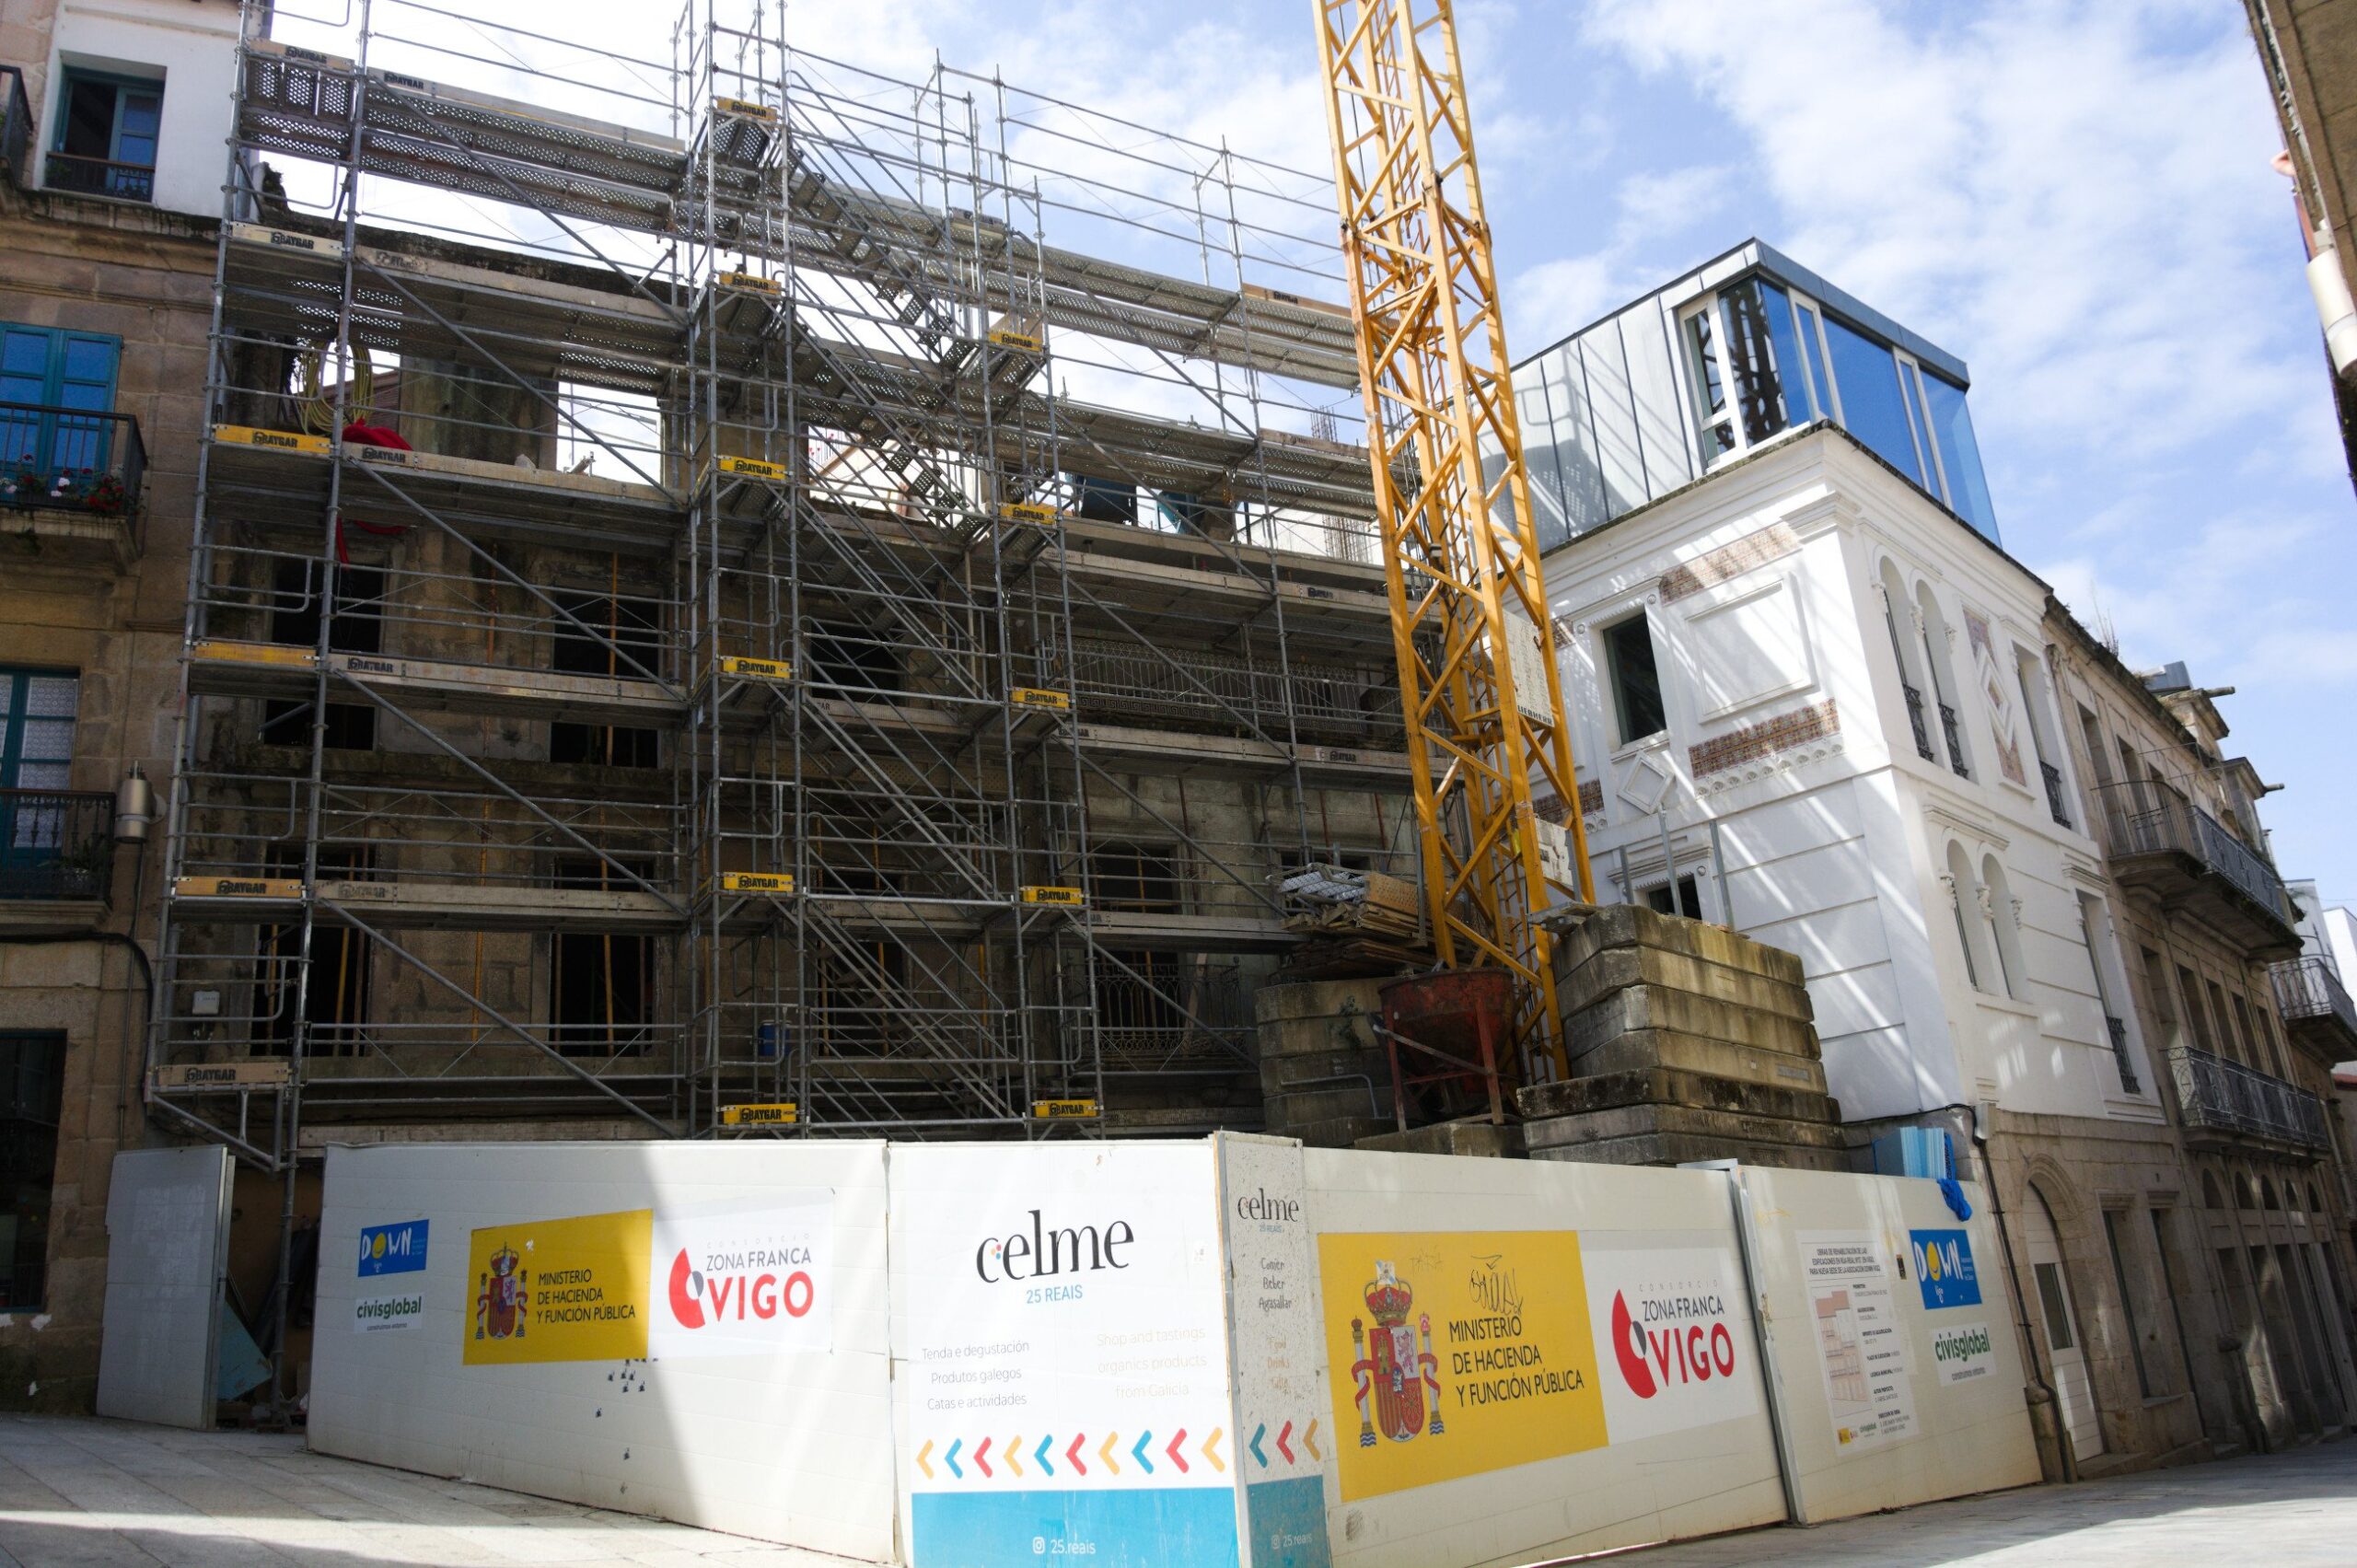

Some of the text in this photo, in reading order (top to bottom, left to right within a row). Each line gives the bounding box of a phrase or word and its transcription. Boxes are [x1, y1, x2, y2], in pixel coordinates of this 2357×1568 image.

[259, 433, 298, 447] BAYGAR
[368, 448, 406, 463] BAYGAR
[740, 461, 772, 475] BAYGAR
[356, 659, 394, 673] BAYGAR
[743, 662, 776, 674] BAYGAR
[1517, 705, 1552, 725] LIEBHERR
[226, 881, 267, 894] BAYGAR
[745, 877, 779, 889] BAYGAR
[1041, 890, 1071, 901] BAYGAR
[193, 1068, 237, 1081] BAYGAR
[746, 1109, 782, 1121] BAYGAR
[1053, 1103, 1085, 1115] BAYGAR
[1237, 1188, 1299, 1222] celme
[361, 1227, 412, 1260] DOWN
[976, 1209, 1134, 1283] celme
[707, 1247, 812, 1272] ZONA FRANCA
[1914, 1238, 1963, 1282] DOWN
[539, 1269, 592, 1286] MINISTERIO
[538, 1288, 603, 1305] DE HACIENDA
[707, 1271, 814, 1322] VIGO
[1027, 1284, 1084, 1304] 25 REAIS
[356, 1295, 422, 1319] civisglobal
[537, 1304, 635, 1324] Y FUNCIÓN PÚBLICA
[1642, 1295, 1724, 1321] ZONA FRANCA
[1449, 1316, 1522, 1342] MINISTERIO
[922, 1341, 1029, 1359] Tenda e degustación
[1935, 1328, 1991, 1362] civisglobal
[1453, 1344, 1542, 1375] DE HACIENDA
[1648, 1323, 1734, 1387] VIGO
[931, 1368, 1022, 1384] Produtos galegos
[1456, 1368, 1585, 1407] Y FUNCIÓN PÚBLICA
[927, 1393, 1028, 1410] Catas e actividades
[1050, 1538, 1096, 1555] 25.reais
